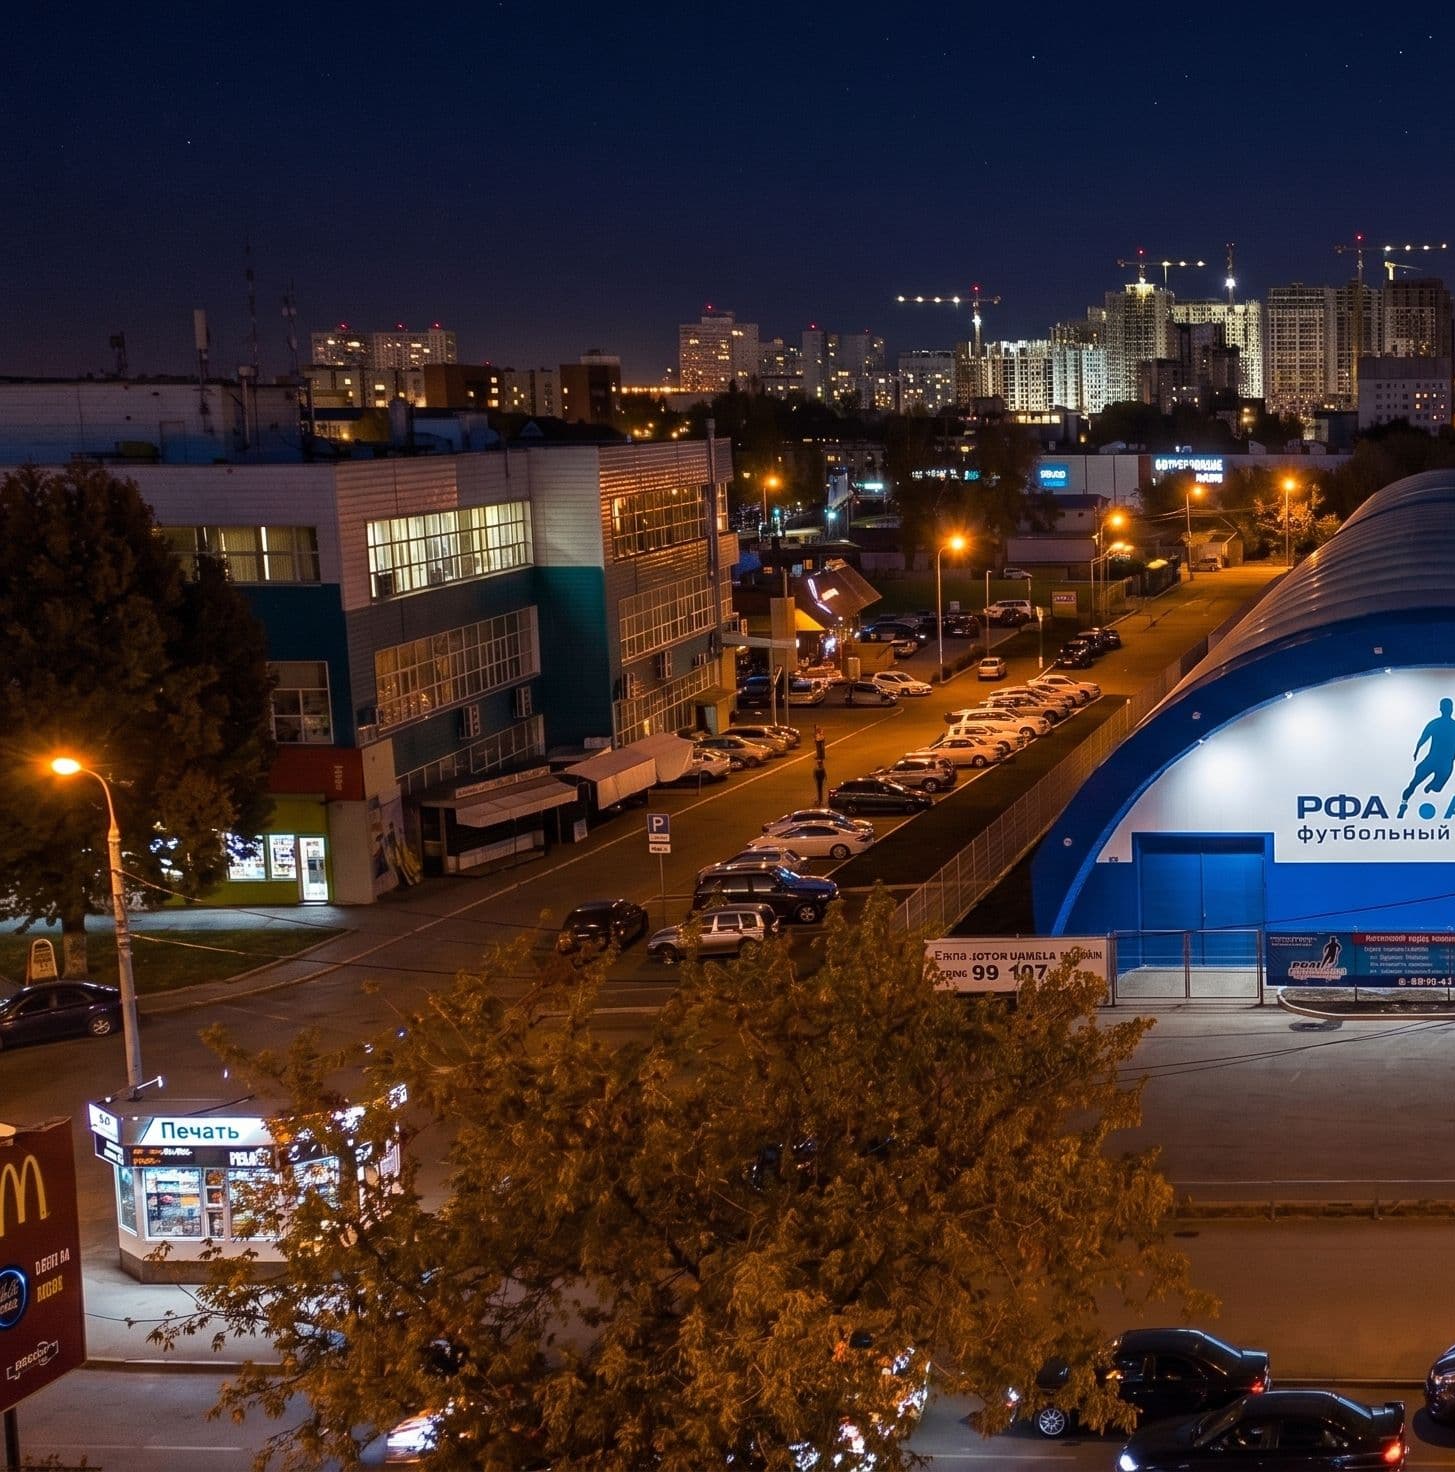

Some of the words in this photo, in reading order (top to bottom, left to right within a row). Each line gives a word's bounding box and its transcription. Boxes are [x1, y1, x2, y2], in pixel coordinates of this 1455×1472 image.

[1297, 794, 1389, 820] РФА
[652, 816, 664, 832] P
[1297, 825, 1450, 844] футбольный
[972, 964, 999, 981] 99
[161, 1121, 240, 1140] Печать
